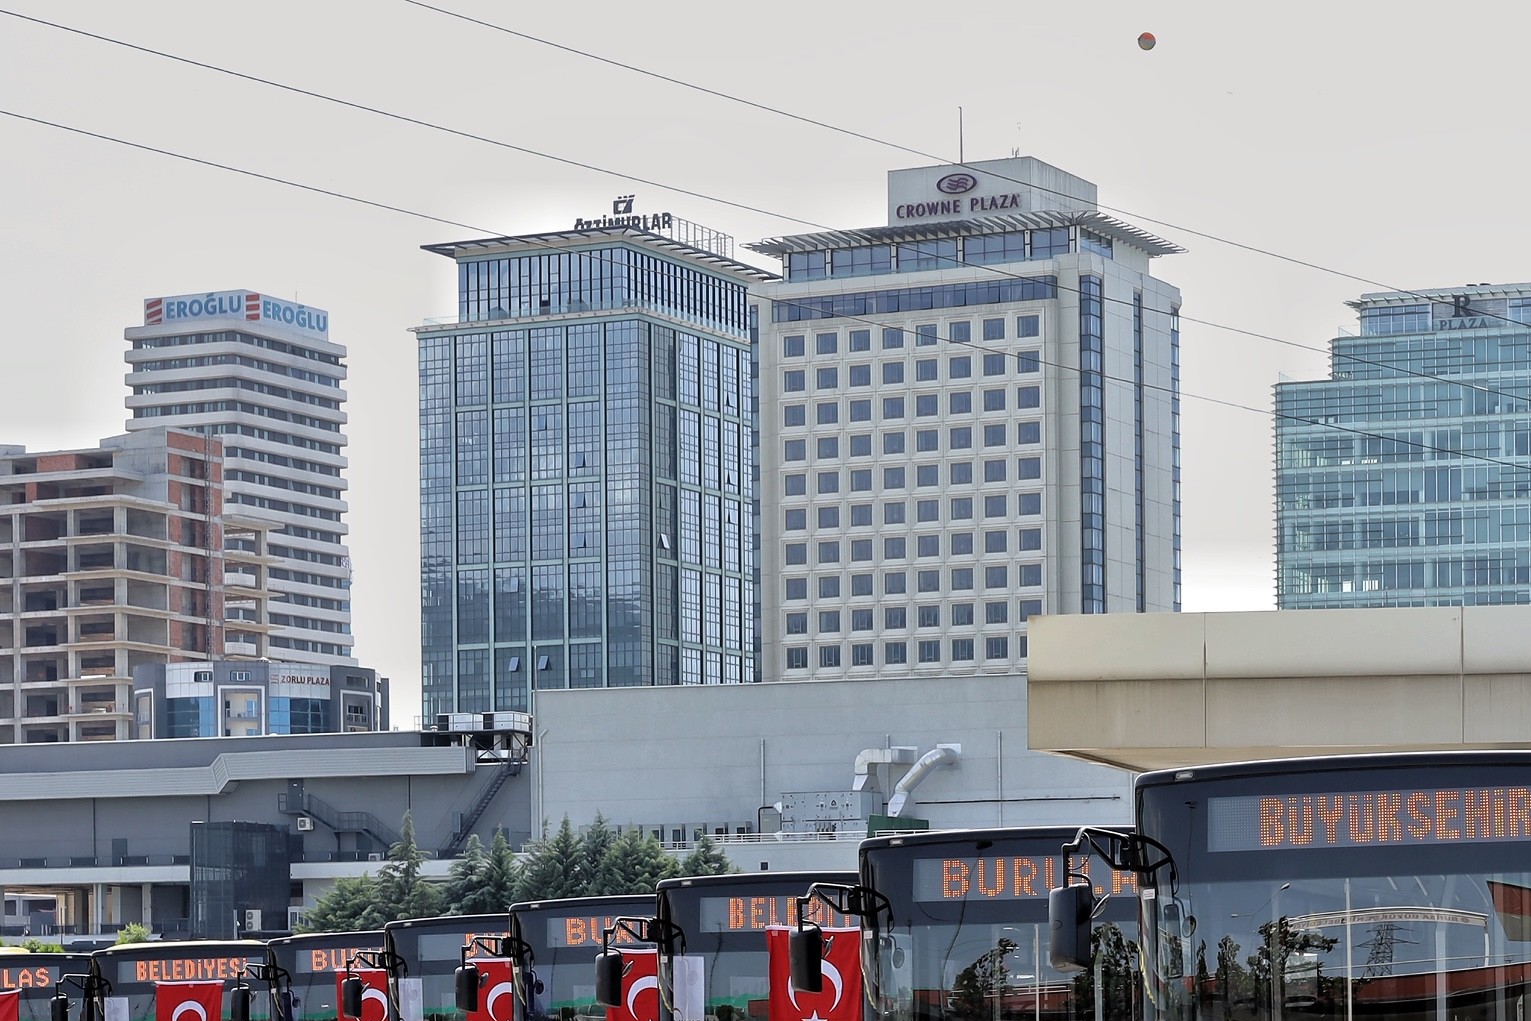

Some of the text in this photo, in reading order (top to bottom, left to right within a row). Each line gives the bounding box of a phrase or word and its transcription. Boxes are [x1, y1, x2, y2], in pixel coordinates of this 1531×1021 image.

[896, 194, 1020, 219] CROWNE PLAZA
[166, 292, 242, 319] EROĞLU
[263, 301, 327, 333] EROĞLU
[281, 675, 330, 686] ZORLU PLAZA
